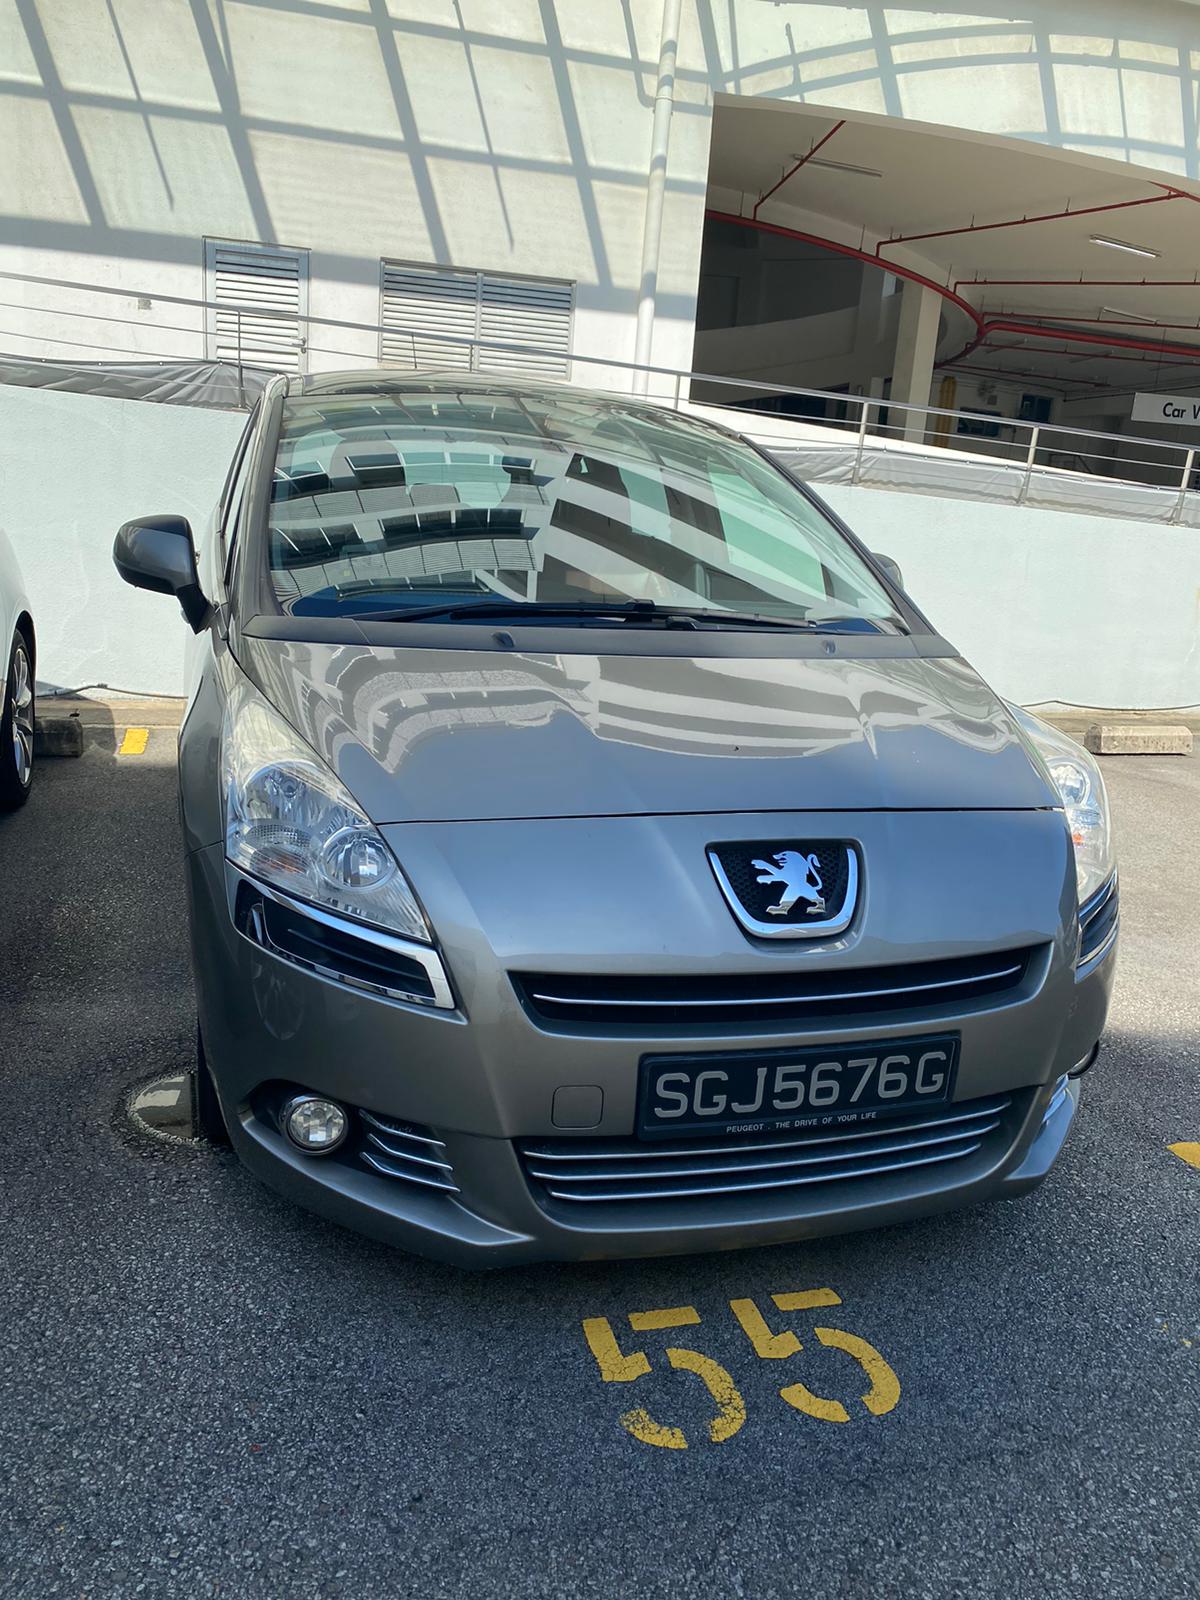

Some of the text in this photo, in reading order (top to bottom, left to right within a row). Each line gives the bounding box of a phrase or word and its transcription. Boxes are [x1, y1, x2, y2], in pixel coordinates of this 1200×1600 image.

[1162, 402, 1186, 419] Car
[654, 1051, 947, 1118] SGJ5676G
[726, 1123, 764, 1133] PEUGEOT
[775, 1121, 790, 1129] THE
[794, 1118, 818, 1127] DRIVE
[822, 1117, 833, 1125] OF
[837, 1113, 858, 1123] YOUR
[861, 1111, 877, 1120] LIFE
[582, 1287, 901, 1449] 55
